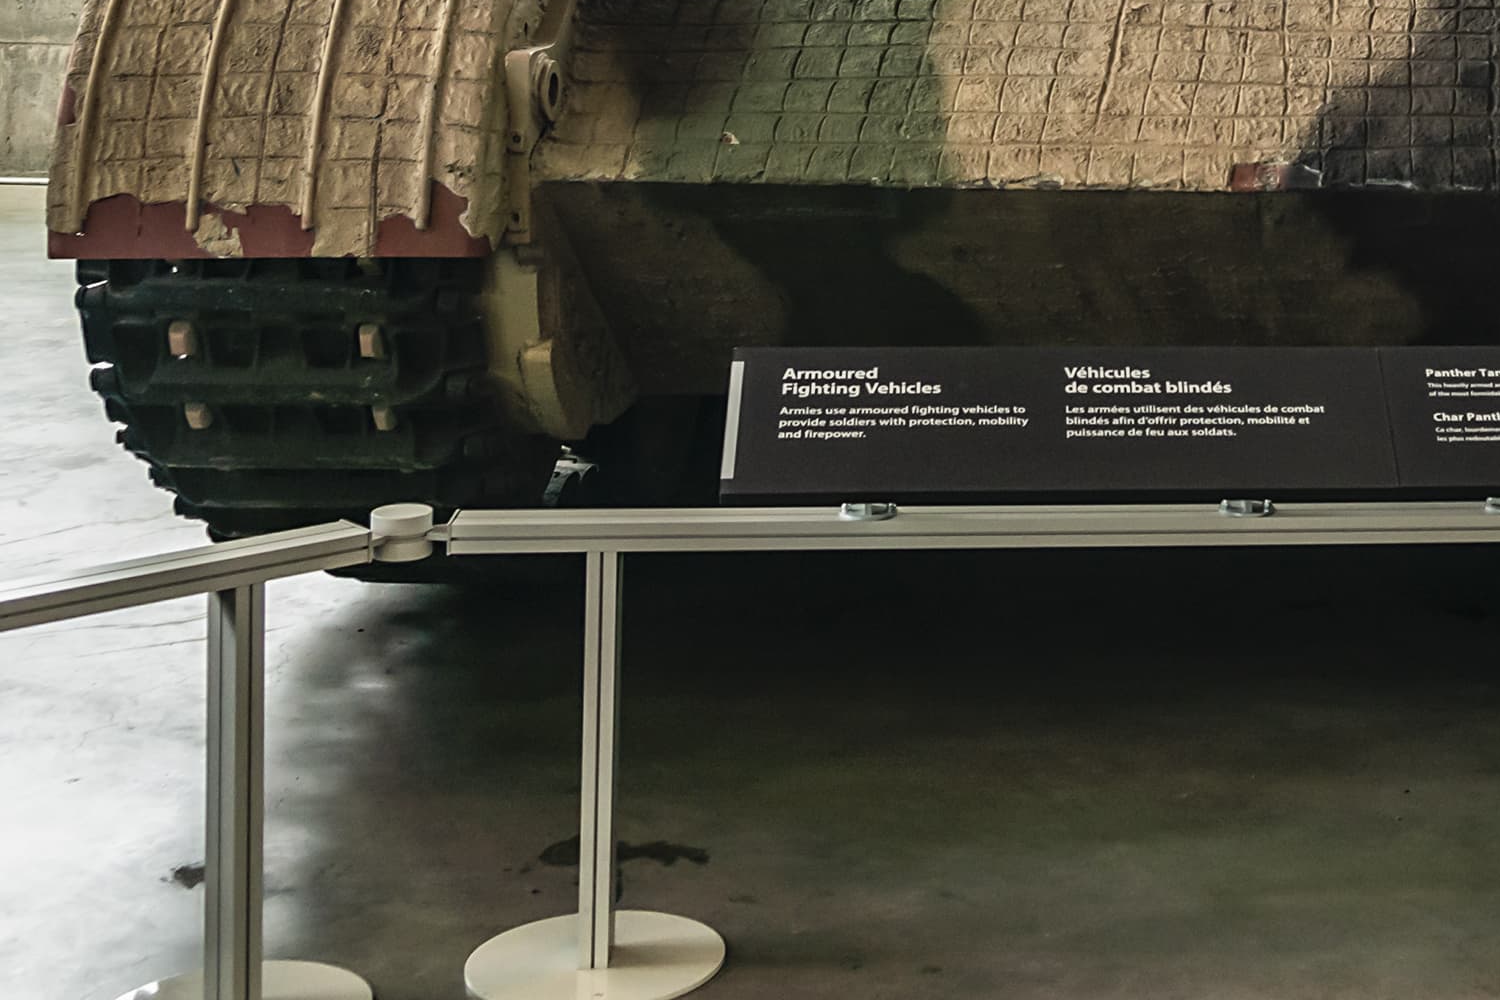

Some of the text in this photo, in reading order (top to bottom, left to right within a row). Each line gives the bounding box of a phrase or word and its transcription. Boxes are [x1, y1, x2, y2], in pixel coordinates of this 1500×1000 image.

[783, 368, 878, 380] Armoured
[1064, 366, 1150, 379] Véhicules
[1426, 369, 1476, 378] Panther
[782, 381, 941, 398] Fighting Vehicles
[1065, 381, 1232, 394] de combat blindés
[779, 407, 822, 416] Armies
[849, 406, 908, 415] armoured
[912, 406, 959, 416] fighting
[962, 405, 1010, 414] vehicles
[1013, 406, 1025, 414] to
[1065, 405, 1325, 414] Les armées utilisent des véhicules de combat
[779, 417, 1028, 428] provide soldiers with protection, mobility
[1066, 417, 1109, 425] blindés
[1112, 416, 1135, 425] afin
[1138, 416, 1177, 425] d'offrir
[1180, 416, 1244, 426] protection,
[1247, 416, 1295, 424] mobilité
[1433, 413, 1464, 422] Char
[778, 430, 867, 440] and firepower.
[1066, 428, 1236, 438] puissance de feu aux soldats.
